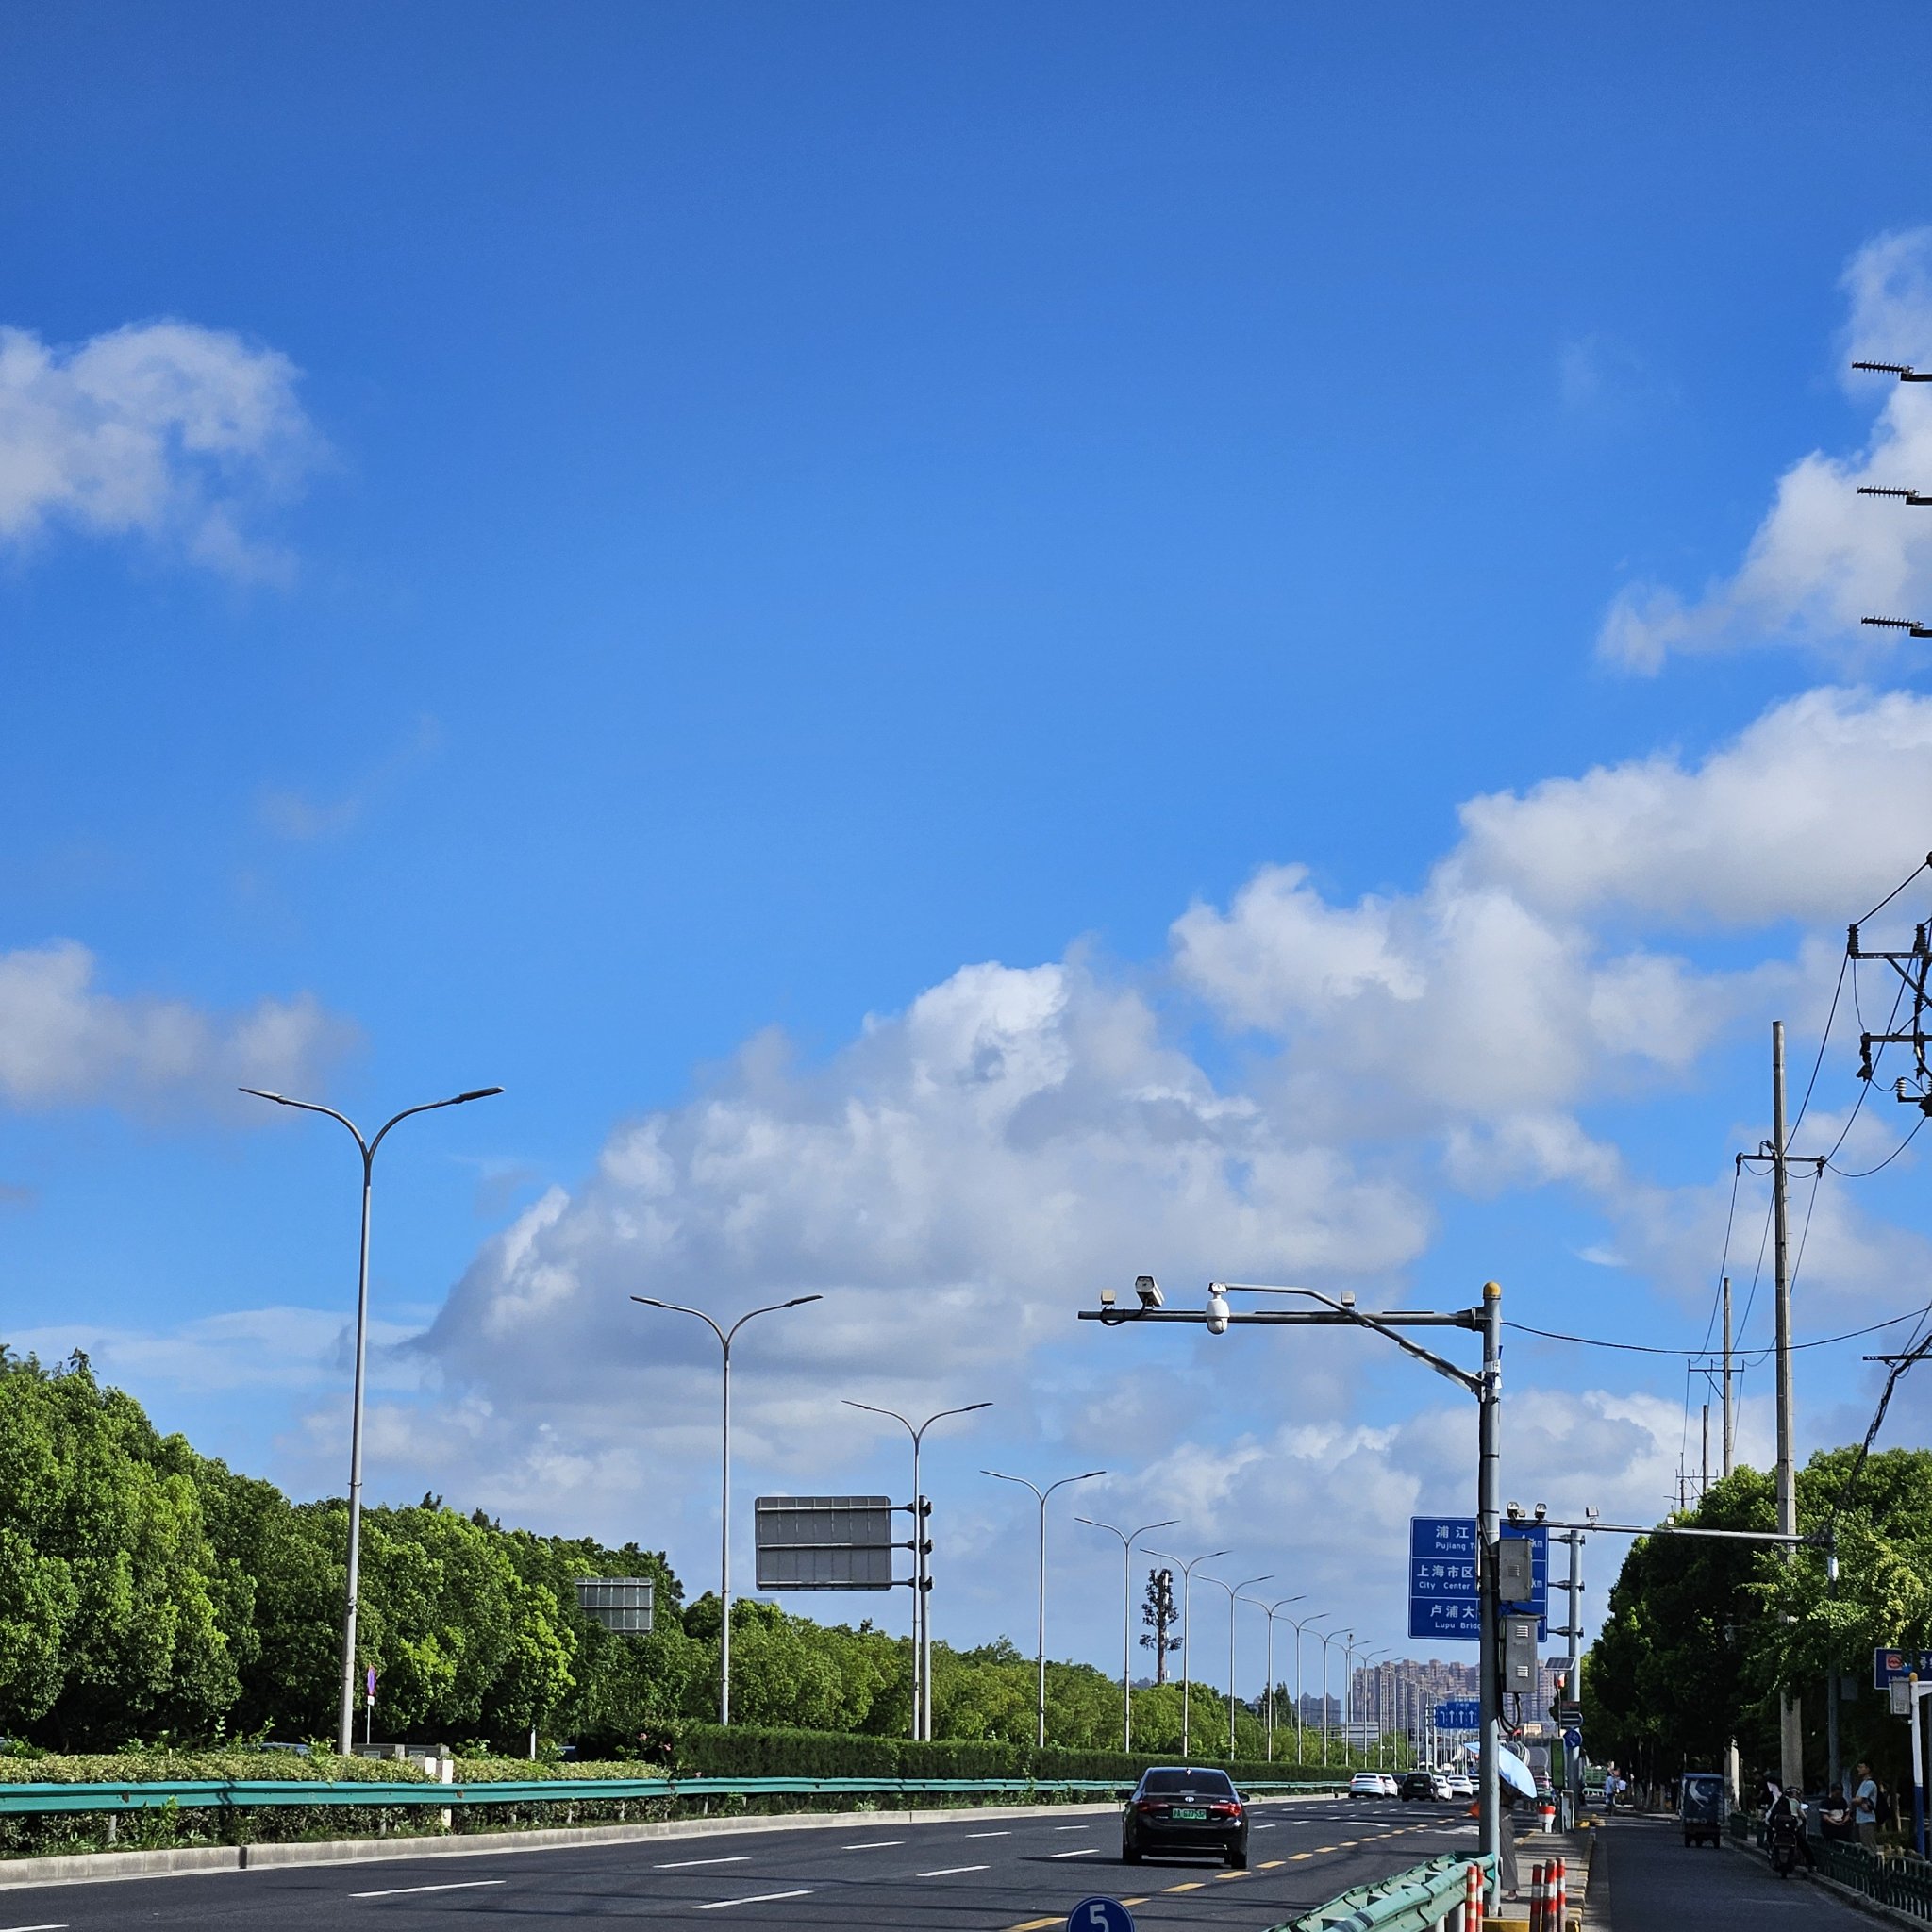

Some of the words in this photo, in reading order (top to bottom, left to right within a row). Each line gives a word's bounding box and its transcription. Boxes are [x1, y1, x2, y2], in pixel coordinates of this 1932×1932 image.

[1435, 1541, 1466, 1552] Pujiang
[1417, 1564, 1474, 1579] 上海市区
[1419, 1581, 1436, 1591] City
[1443, 1582, 1471, 1591] Center
[1435, 1622, 1456, 1630] Lupu
[1089, 1904, 1109, 1932] 5
